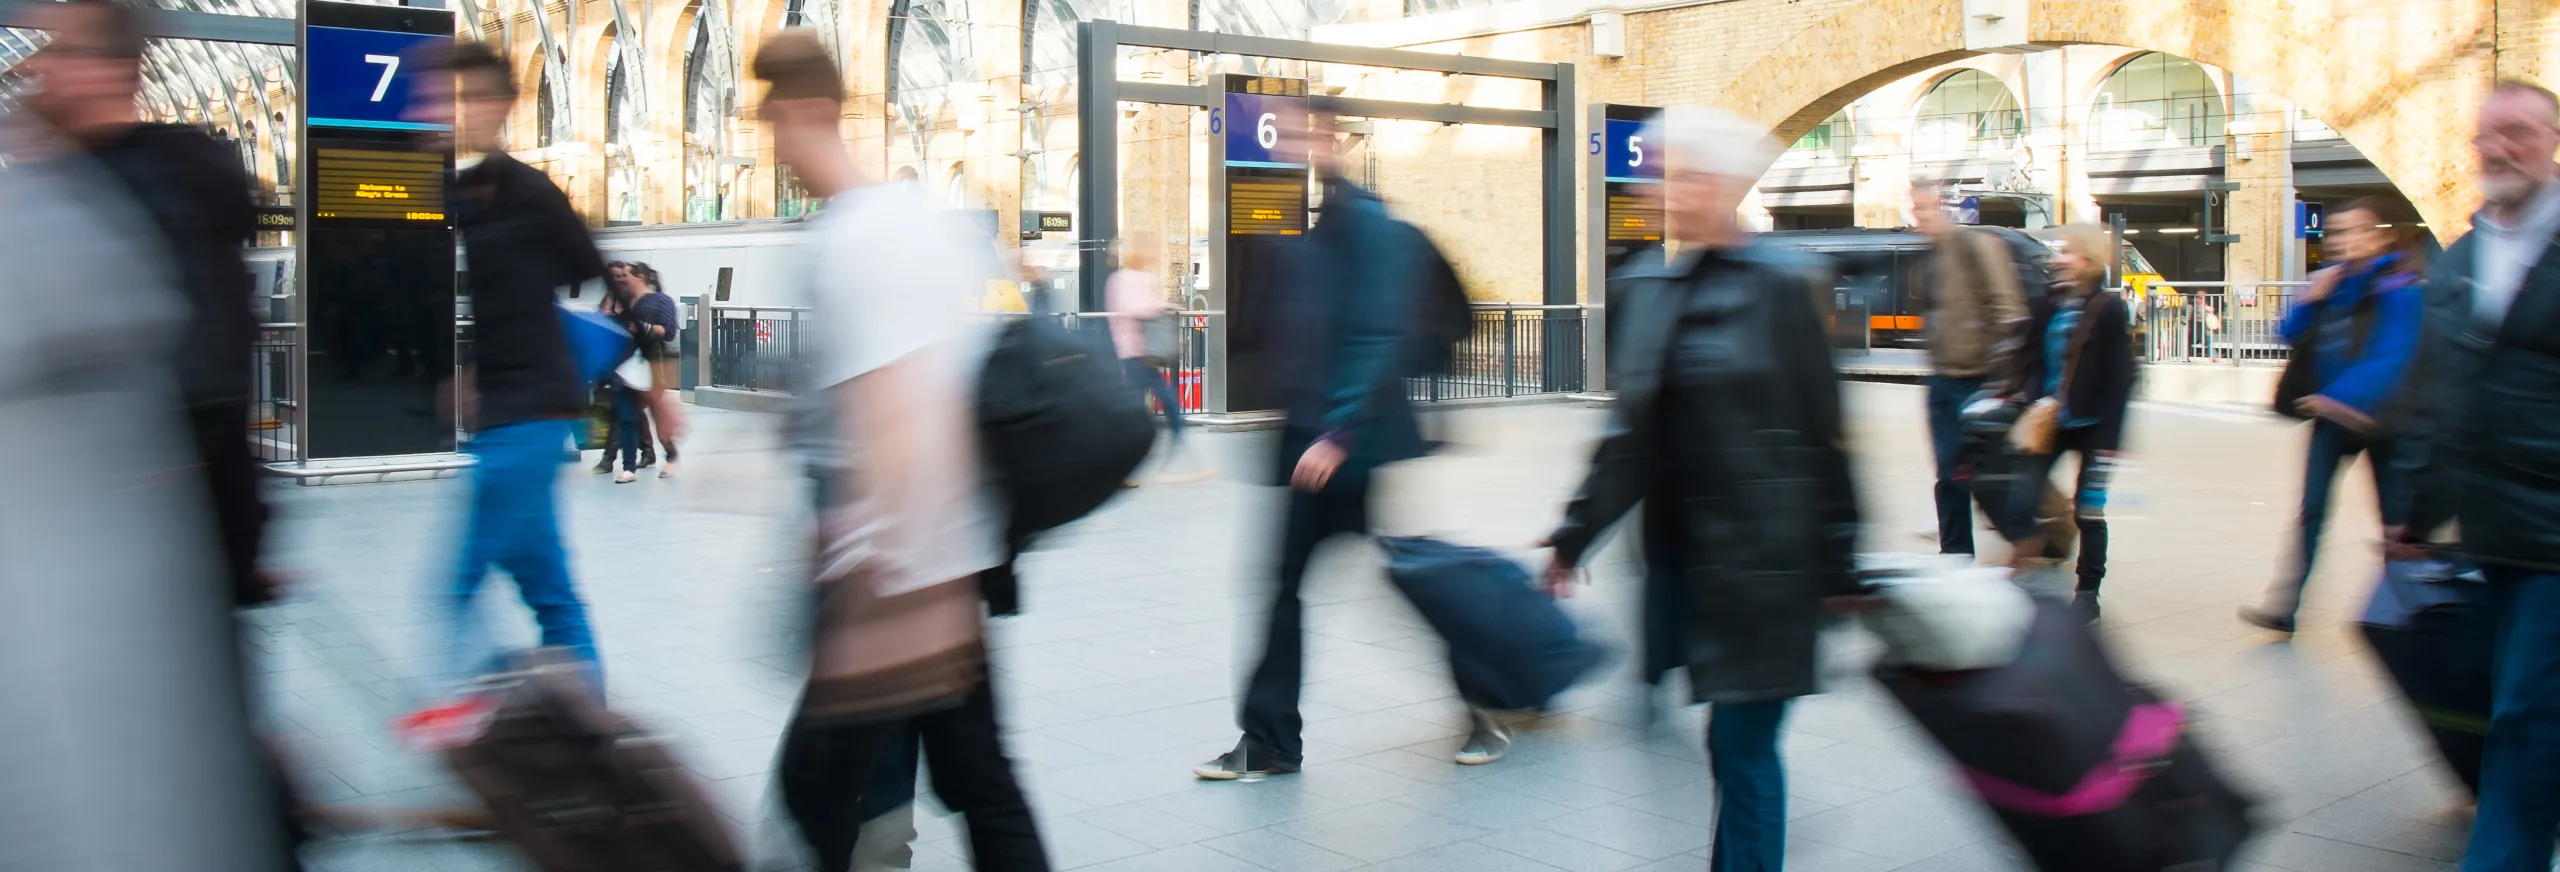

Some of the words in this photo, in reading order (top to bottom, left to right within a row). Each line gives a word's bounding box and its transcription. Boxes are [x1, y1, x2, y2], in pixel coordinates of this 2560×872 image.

[365, 54, 400, 102] 7
[1210, 107, 1222, 135] 6
[1257, 112, 1278, 150] 6
[1590, 132, 1602, 156] 5
[1628, 135, 1643, 167] 5
[2311, 213, 2318, 229] 0
